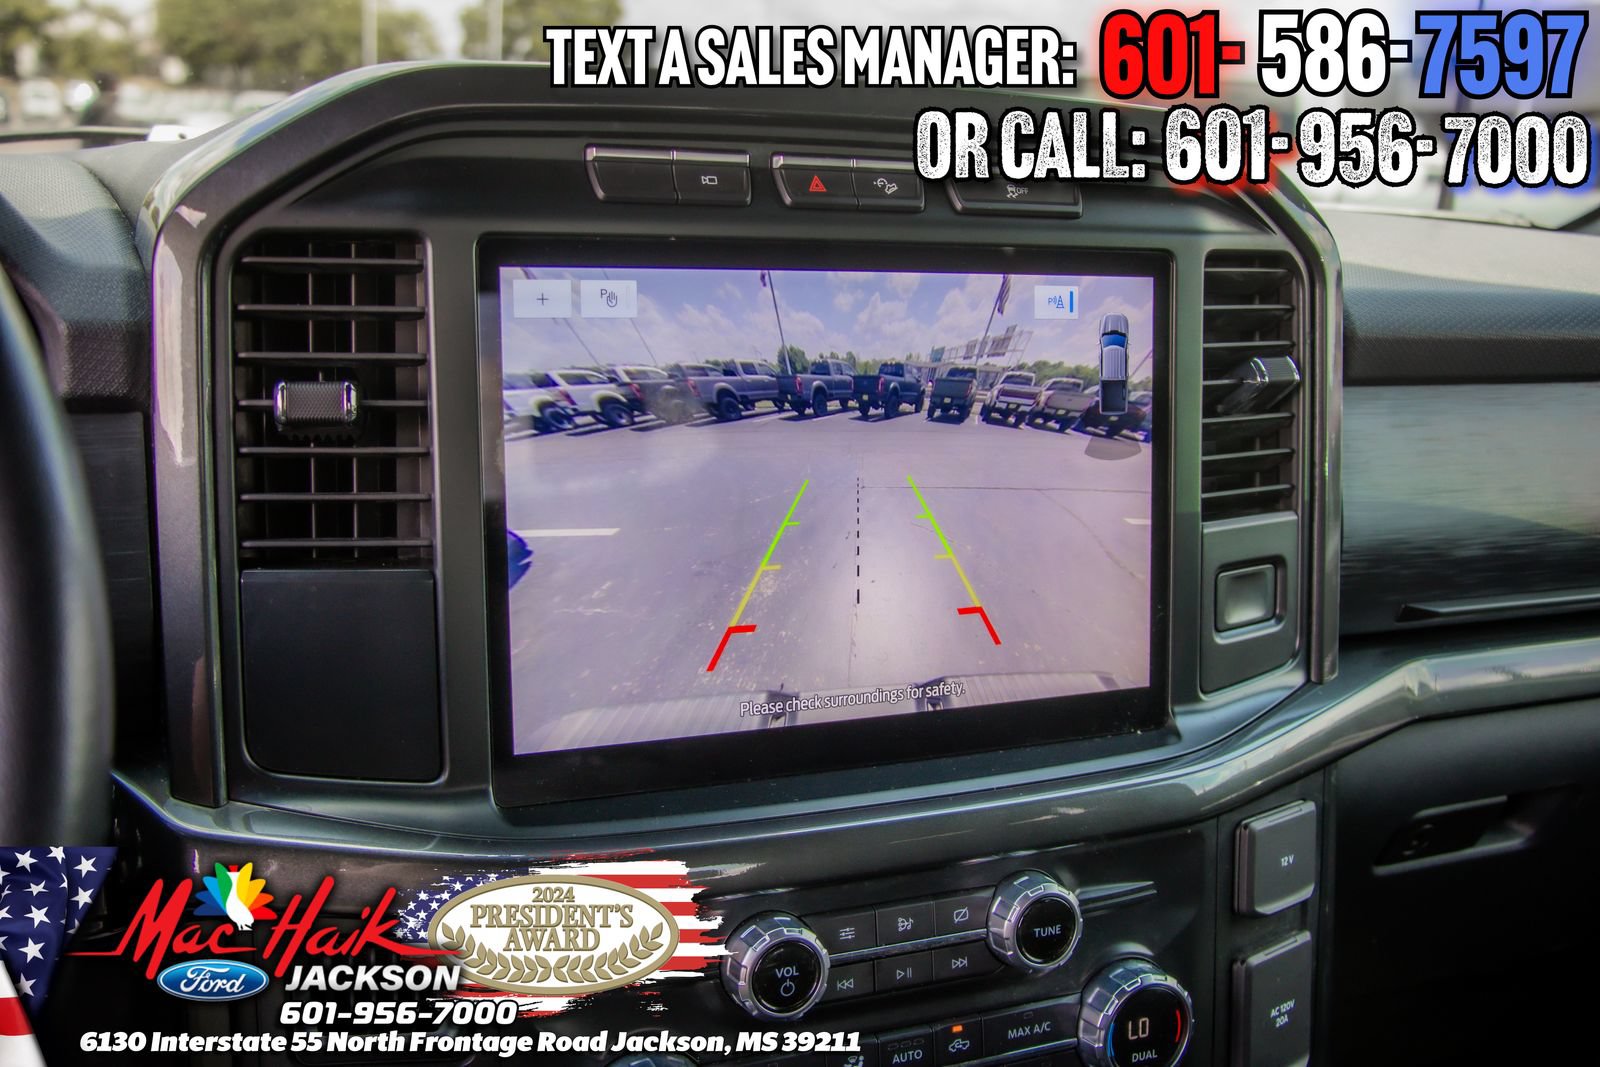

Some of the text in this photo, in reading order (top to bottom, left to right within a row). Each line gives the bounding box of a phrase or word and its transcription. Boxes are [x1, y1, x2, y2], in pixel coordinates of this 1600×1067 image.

[1017, 187, 1029, 195] OFF
[740, 681, 966, 717] Please check surroundings for safety.
[1033, 924, 1063, 938] TUNE
[775, 967, 800, 979] VOL
[1270, 998, 1296, 1018] AC 120V
[1275, 1013, 1289, 1028] 20A
[1007, 1021, 1052, 1040] MAX A/C
[892, 1049, 923, 1064] AUTO
[1131, 1049, 1158, 1063] DUAL
